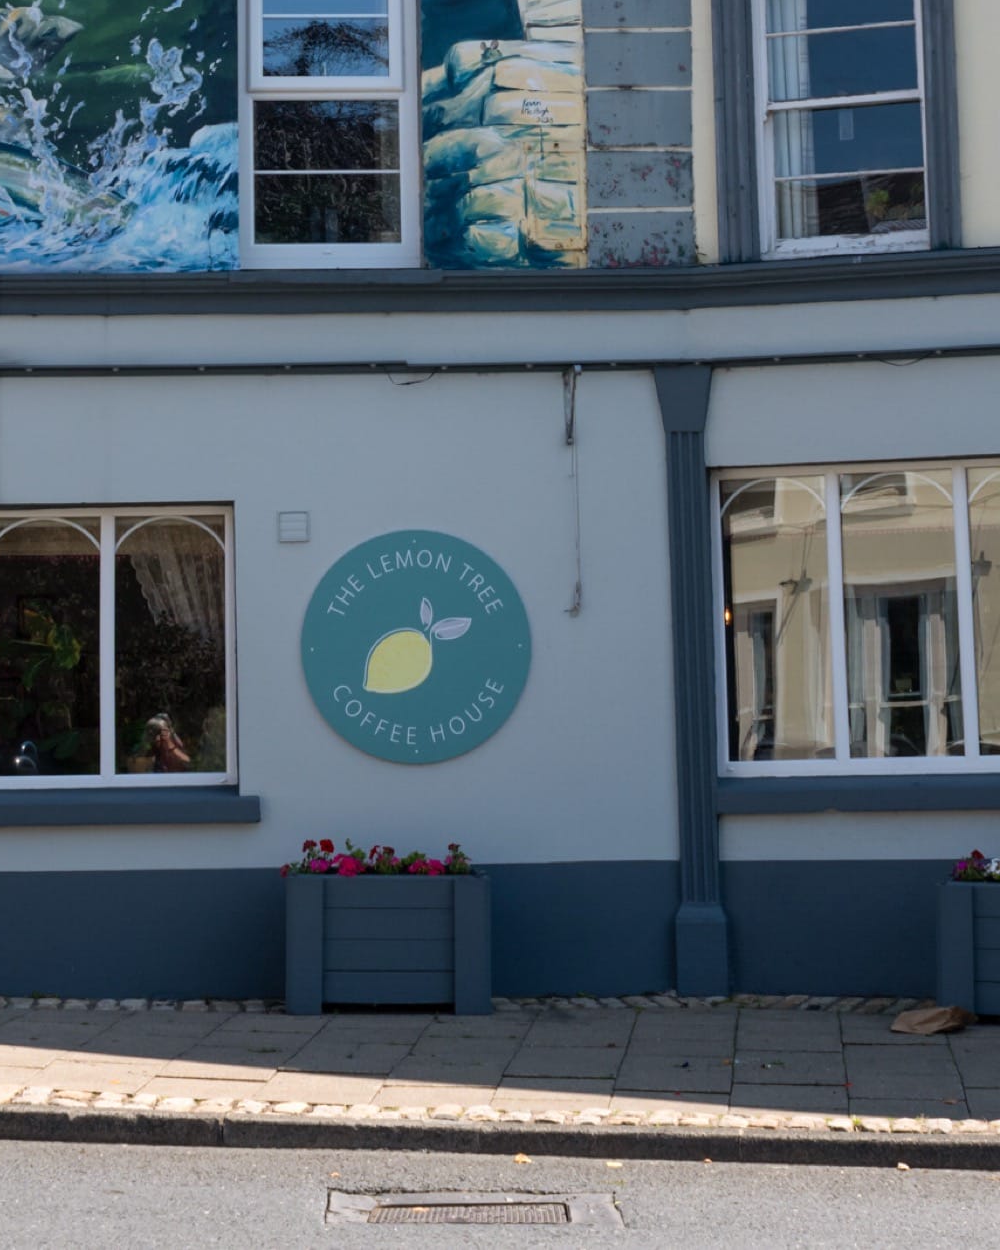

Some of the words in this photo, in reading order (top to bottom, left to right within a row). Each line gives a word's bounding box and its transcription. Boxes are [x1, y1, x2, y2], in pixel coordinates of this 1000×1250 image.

[327, 573, 365, 617] THE
[366, 549, 452, 579] LEMON
[458, 562, 504, 615] TREE
[333, 684, 417, 745] COFFEE
[429, 677, 505, 743] HOUSE
